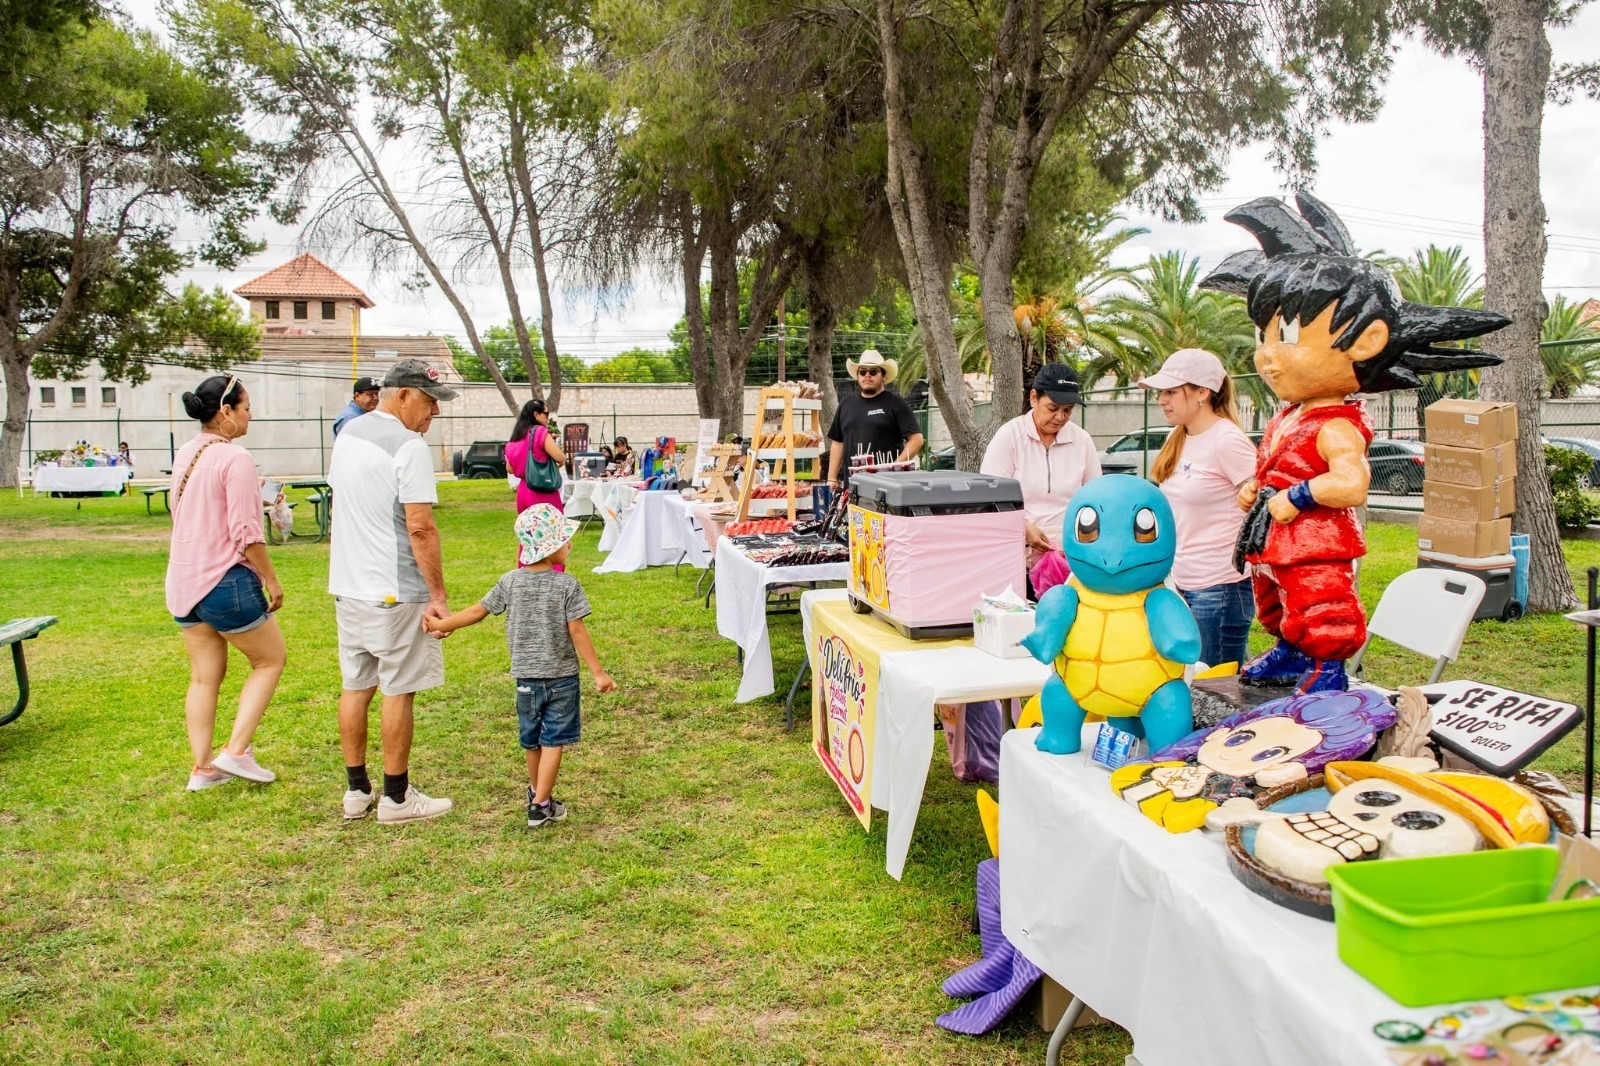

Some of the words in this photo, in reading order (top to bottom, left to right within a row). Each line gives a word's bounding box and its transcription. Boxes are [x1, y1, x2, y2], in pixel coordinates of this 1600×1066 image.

[1449, 688, 1498, 709] SE
[1486, 696, 1564, 727] RIFA
[1471, 735, 1513, 752] BOLETO
